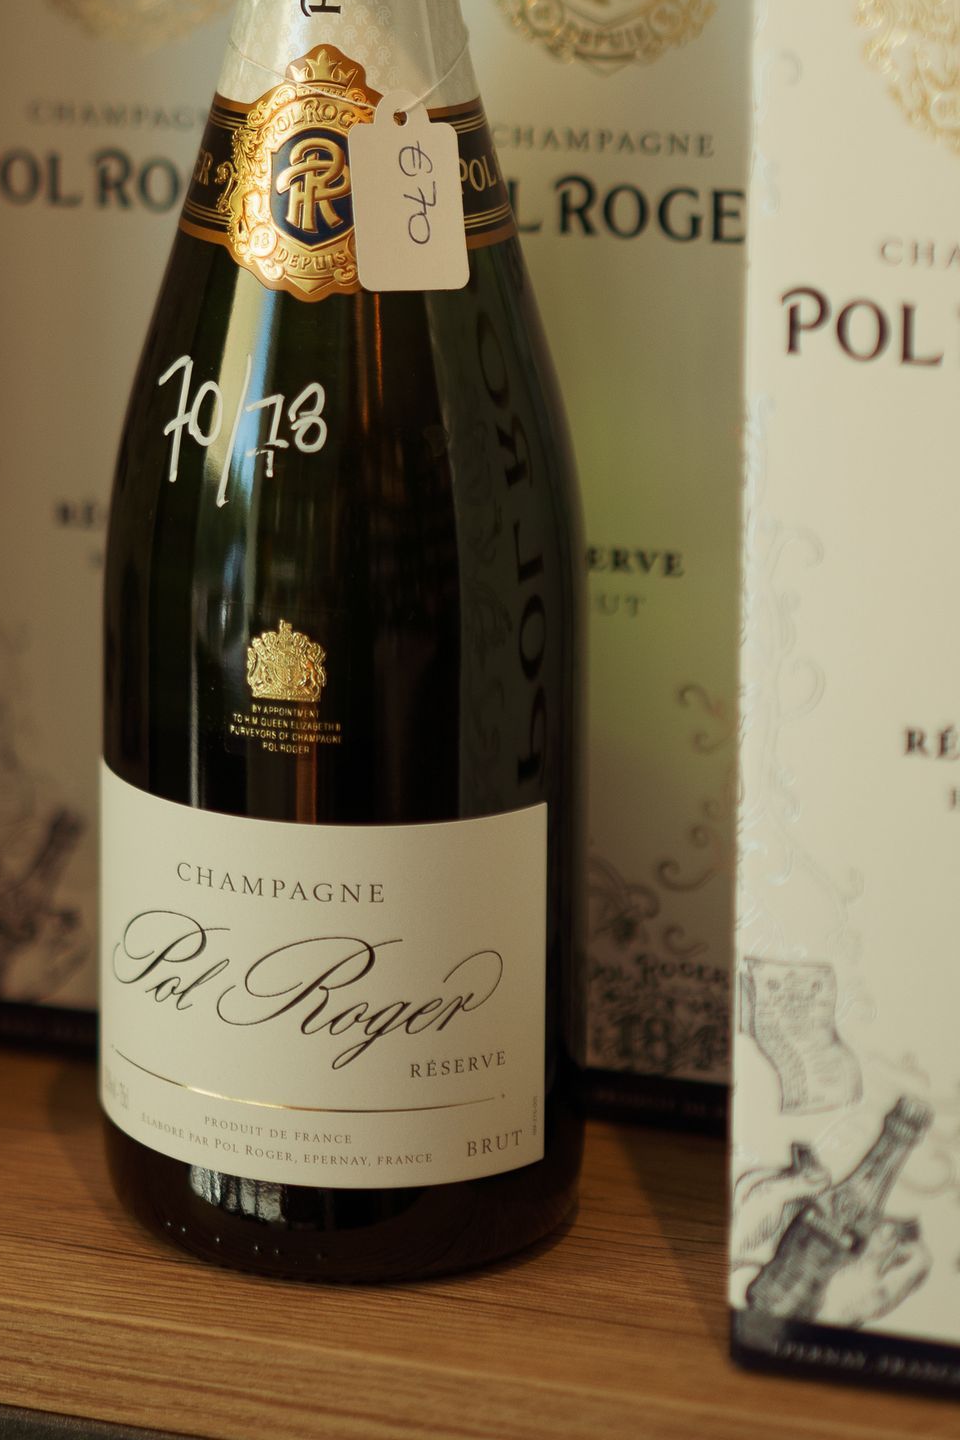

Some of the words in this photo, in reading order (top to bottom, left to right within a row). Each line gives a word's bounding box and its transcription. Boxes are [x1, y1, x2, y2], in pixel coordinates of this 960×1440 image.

[273, 246, 348, 273] DEPUIS
[781, 287, 945, 366] POL
[260, 717, 289, 729] QUEEN
[263, 706, 320, 719] APPOINTMENT
[230, 723, 277, 740] PURVEYORS
[176, 860, 386, 904] CHAMPAGNE
[112, 909, 231, 1011] Pol
[216, 936, 504, 1070] Roger
[410, 1050, 506, 1079] RÉSERVE
[204, 1115, 264, 1137] PRODUIT
[269, 1128, 287, 1140] DE
[294, 1131, 353, 1145] FRANCE
[466, 1129, 524, 1158] BRUT
[214, 1138, 239, 1154] POL
[245, 1144, 298, 1164] ROGER,
[303, 1153, 372, 1168] EPERNAY,
[377, 1153, 433, 1166] FRANCE
